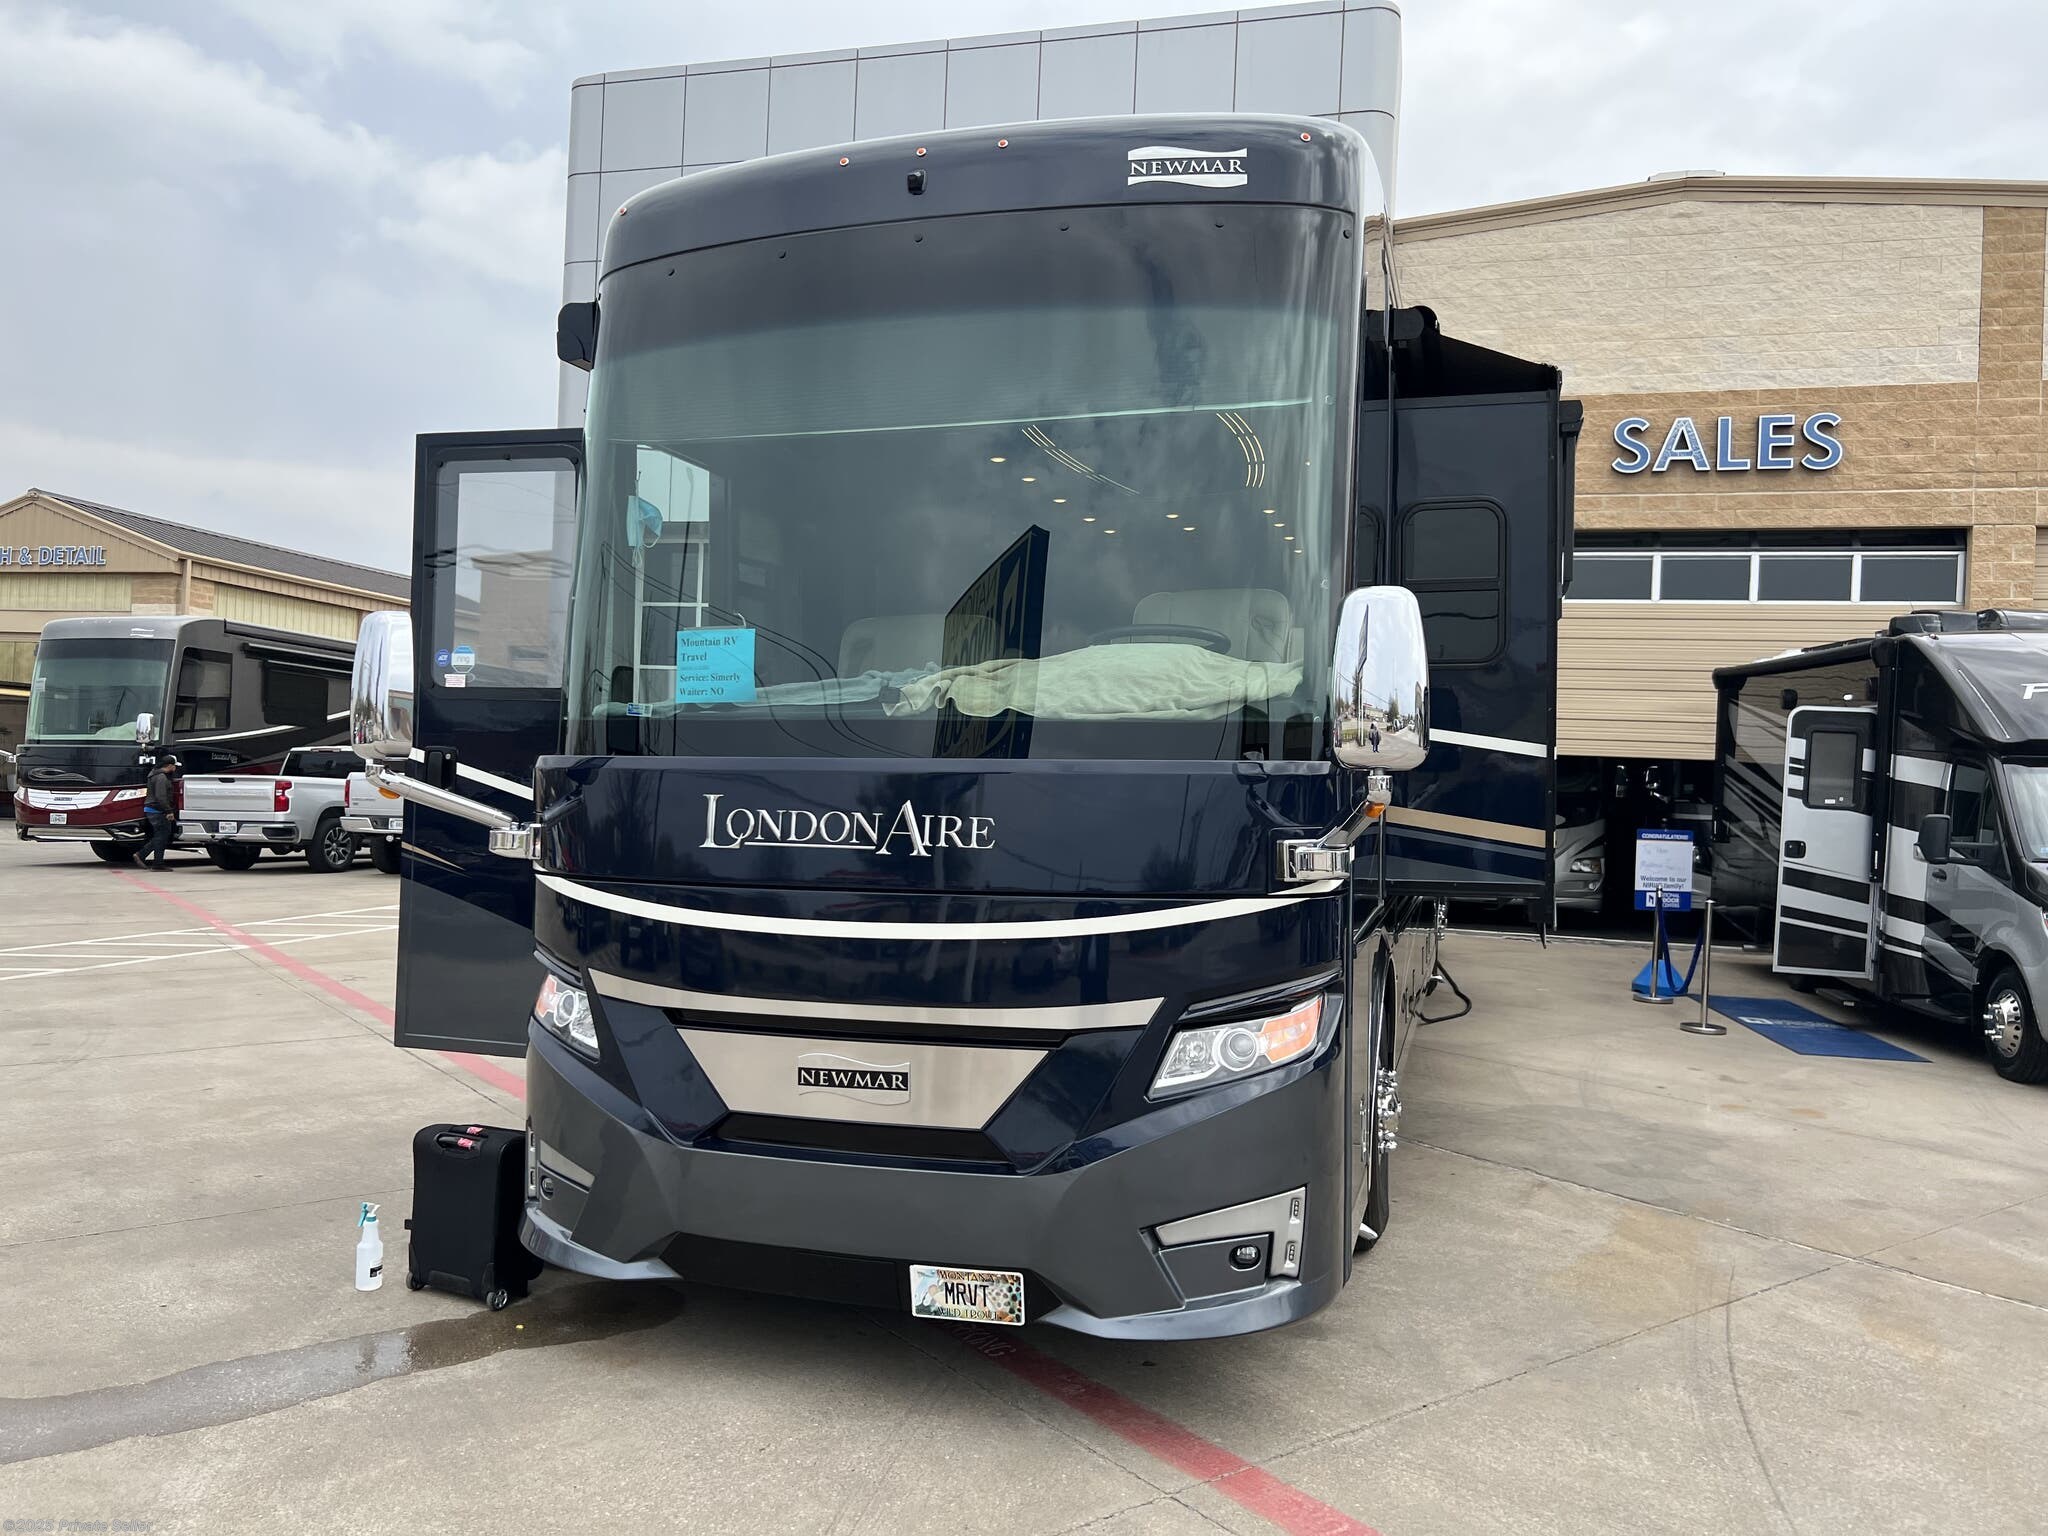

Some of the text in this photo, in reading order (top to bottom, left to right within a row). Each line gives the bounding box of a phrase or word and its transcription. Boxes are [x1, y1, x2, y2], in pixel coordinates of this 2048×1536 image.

[1130, 159, 1245, 175] NEWMAR
[1612, 412, 1843, 474] SALES
[18, 546, 32, 566] &
[38, 545, 106, 566] DETAIL
[681, 636, 738, 648] Mountain RV
[681, 651, 707, 662] Travel
[680, 672, 741, 684] Service: Simerly
[680, 687, 725, 697] Waiter: NO
[799, 1069, 908, 1090] NEWMAR
[936, 1269, 996, 1282] MONTANA
[944, 1281, 989, 1307] MRVT
